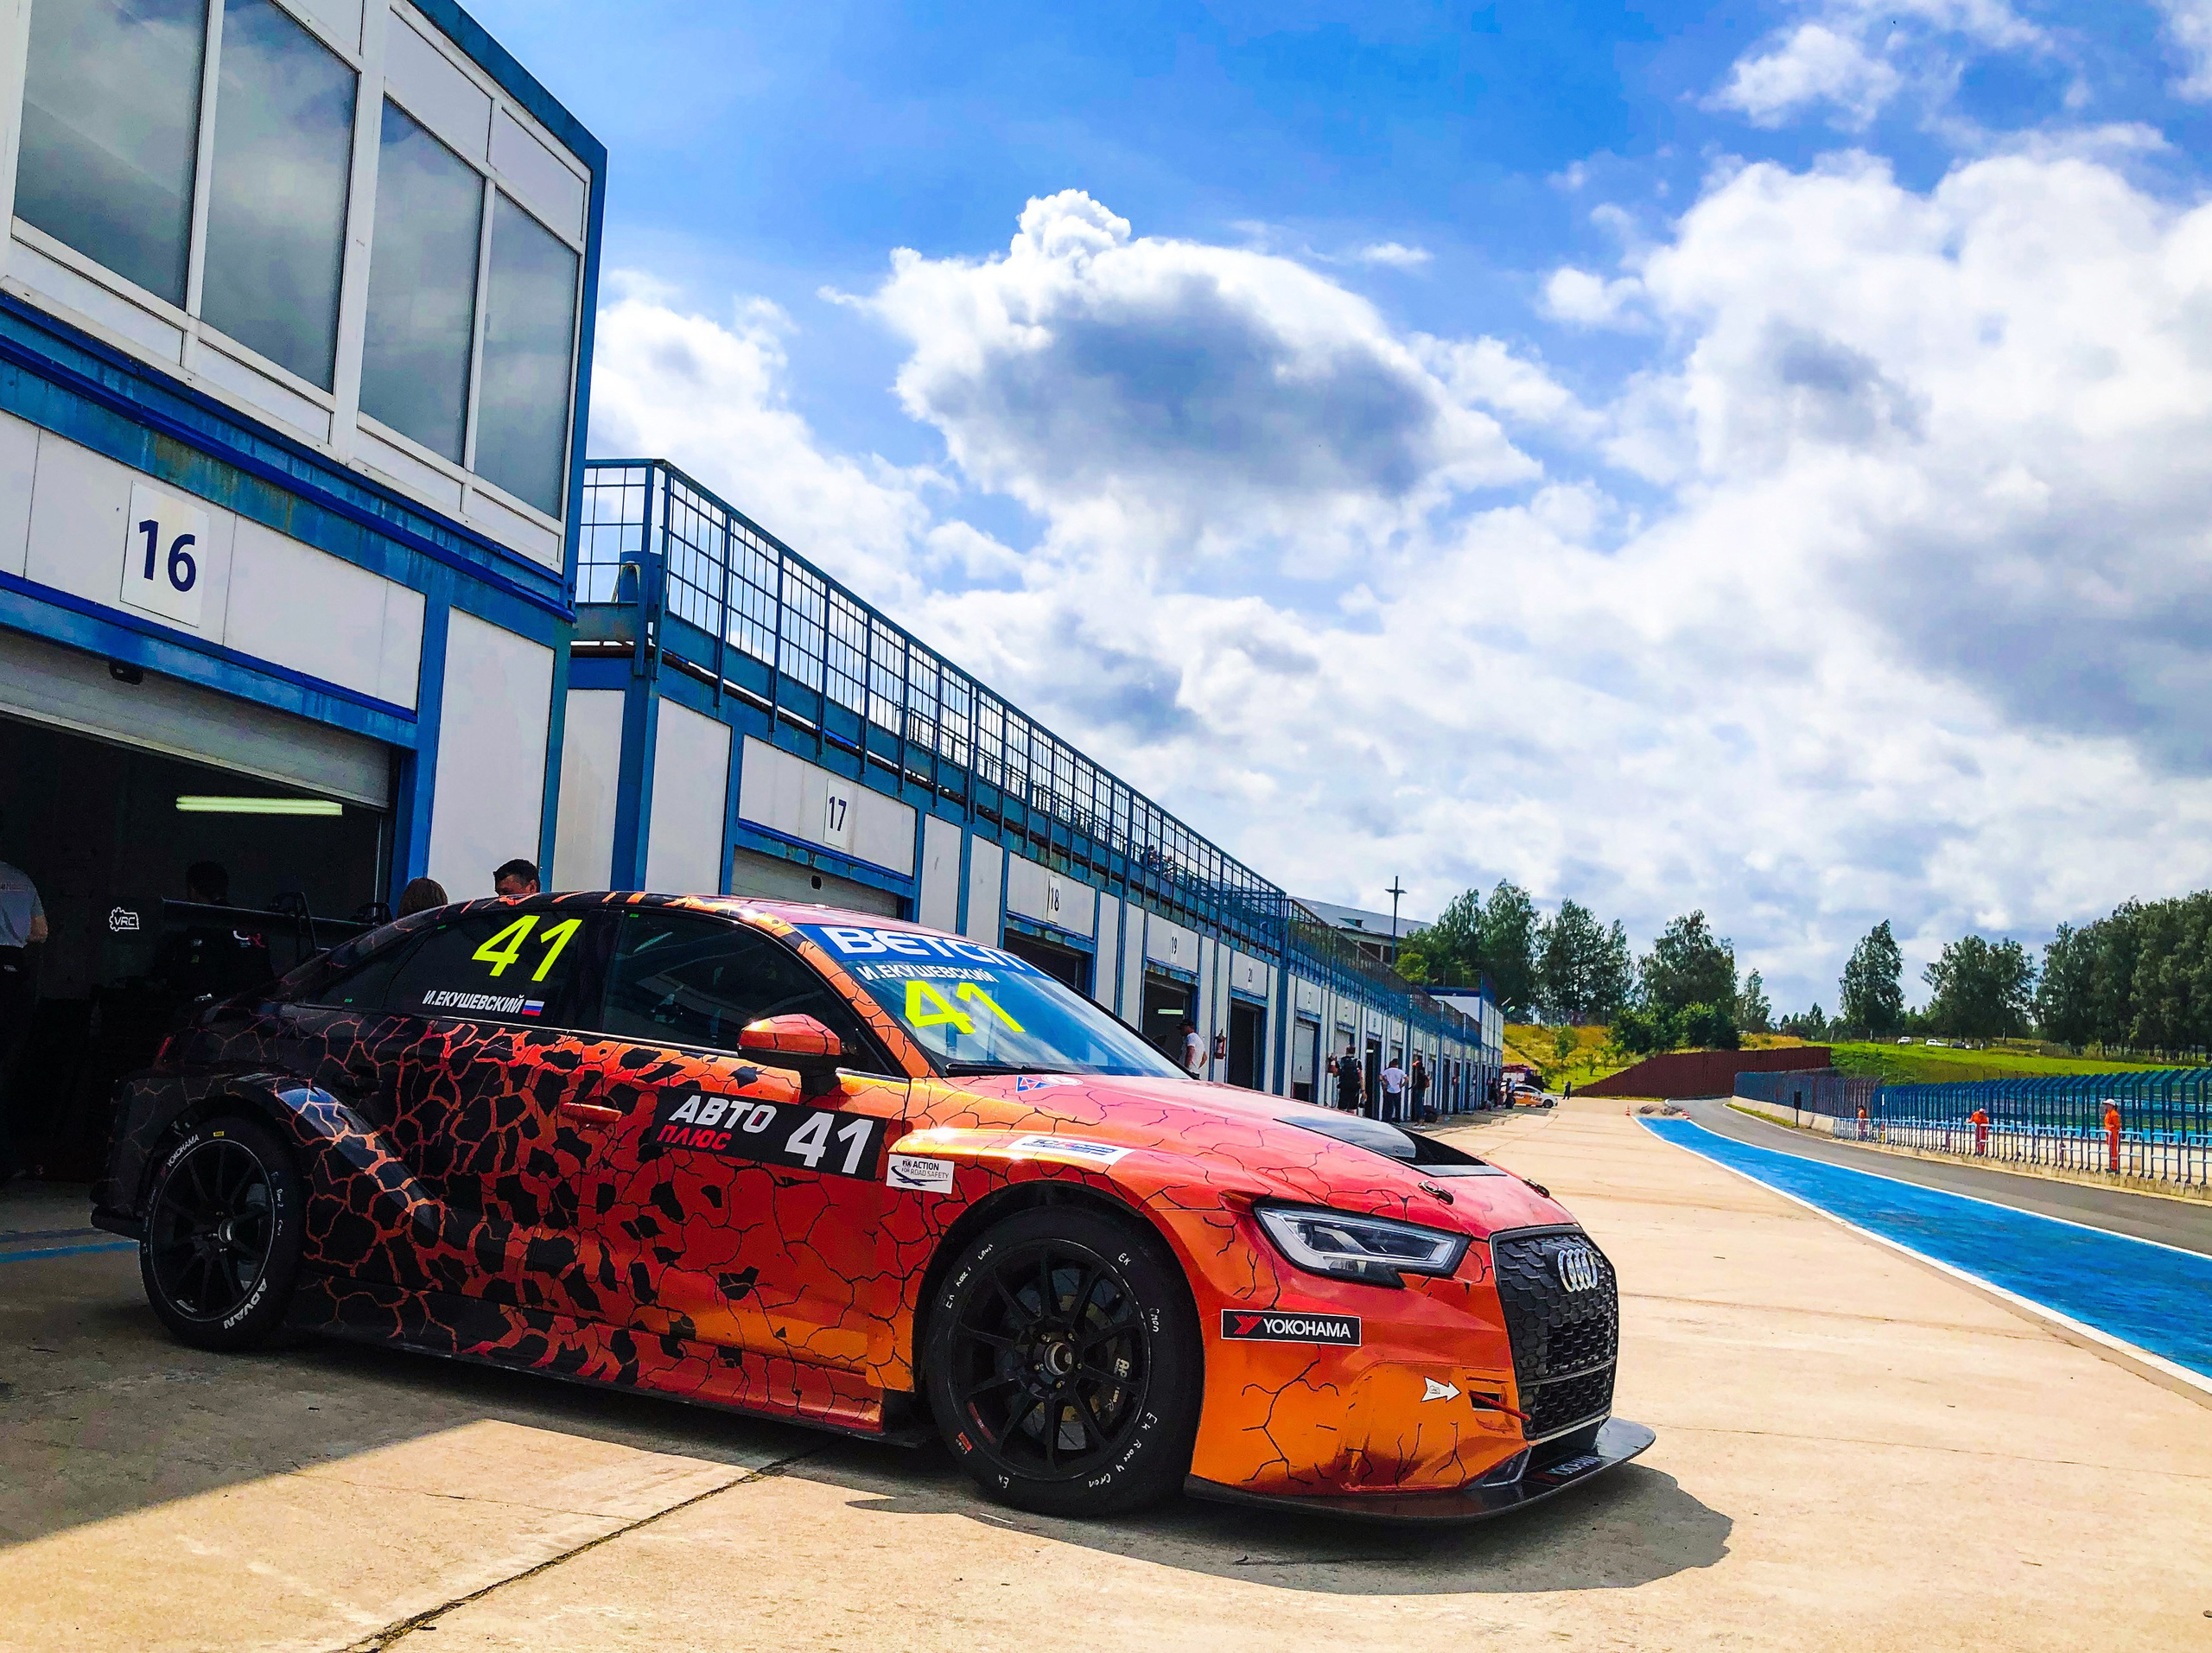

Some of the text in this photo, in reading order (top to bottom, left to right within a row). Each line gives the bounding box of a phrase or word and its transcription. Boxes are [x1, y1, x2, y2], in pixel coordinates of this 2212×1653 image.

[139, 519, 197, 593] 16
[830, 796, 847, 831] 17
[1051, 887, 1059, 912] 18
[114, 916, 136, 926] VRC
[472, 915, 583, 982] 41
[1171, 936, 1178, 955] 19
[856, 964, 1000, 983] И.ЕКУШЕВСКИЙ
[423, 989, 524, 1014] И.ЕКУШЕВСКИЙ
[905, 980, 1027, 1034] 41
[669, 1095, 777, 1134] АВТО
[657, 1125, 732, 1150] ПЛЮС
[785, 1111, 874, 1175] 41
[167, 1134, 200, 1167] YOKOHAMA
[912, 1160, 939, 1171] ACTION
[927, 1171, 950, 1179] SAFETY
[223, 1278, 267, 1329] ADVAN
[1262, 1318, 1351, 1338] YOKOHAMA
